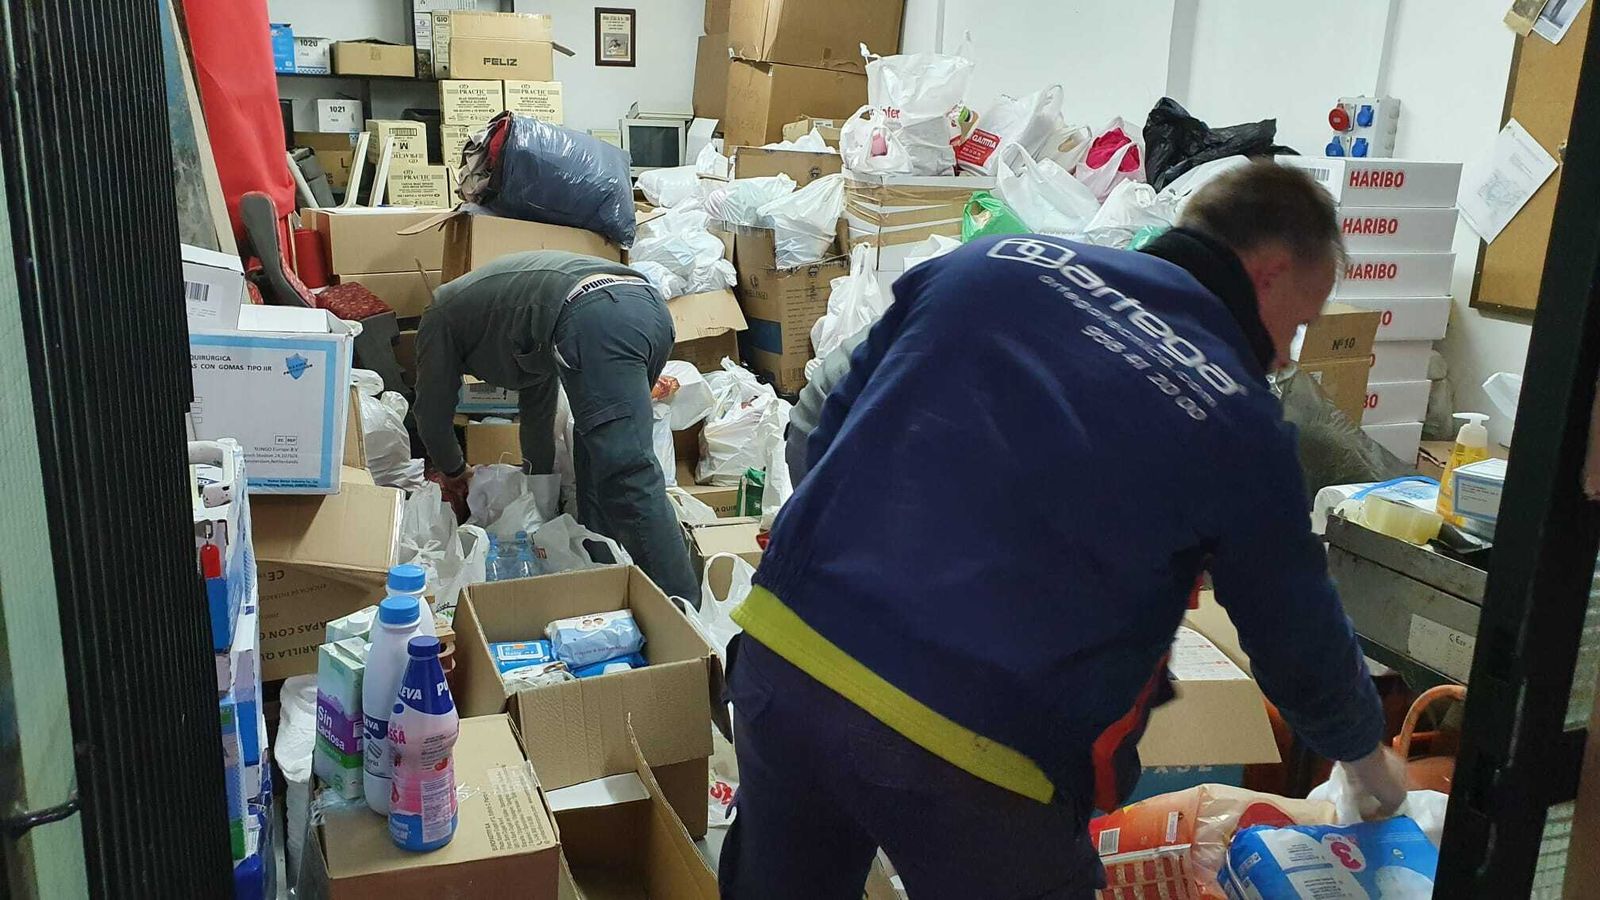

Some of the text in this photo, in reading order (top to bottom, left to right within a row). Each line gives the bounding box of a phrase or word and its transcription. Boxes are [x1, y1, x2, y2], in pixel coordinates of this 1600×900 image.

[483, 57, 518, 67] FELIZ
[1349, 170, 1405, 188] HARIBO
[1342, 218, 1398, 234] HARIBO
[1344, 263, 1397, 279] HARIBO
[1059, 264, 1242, 396] artega
[1081, 324, 1208, 420] 958 41 20 00
[268, 627, 295, 640] CON
[317, 704, 332, 727] Sin
[317, 722, 345, 751] Lactosa
